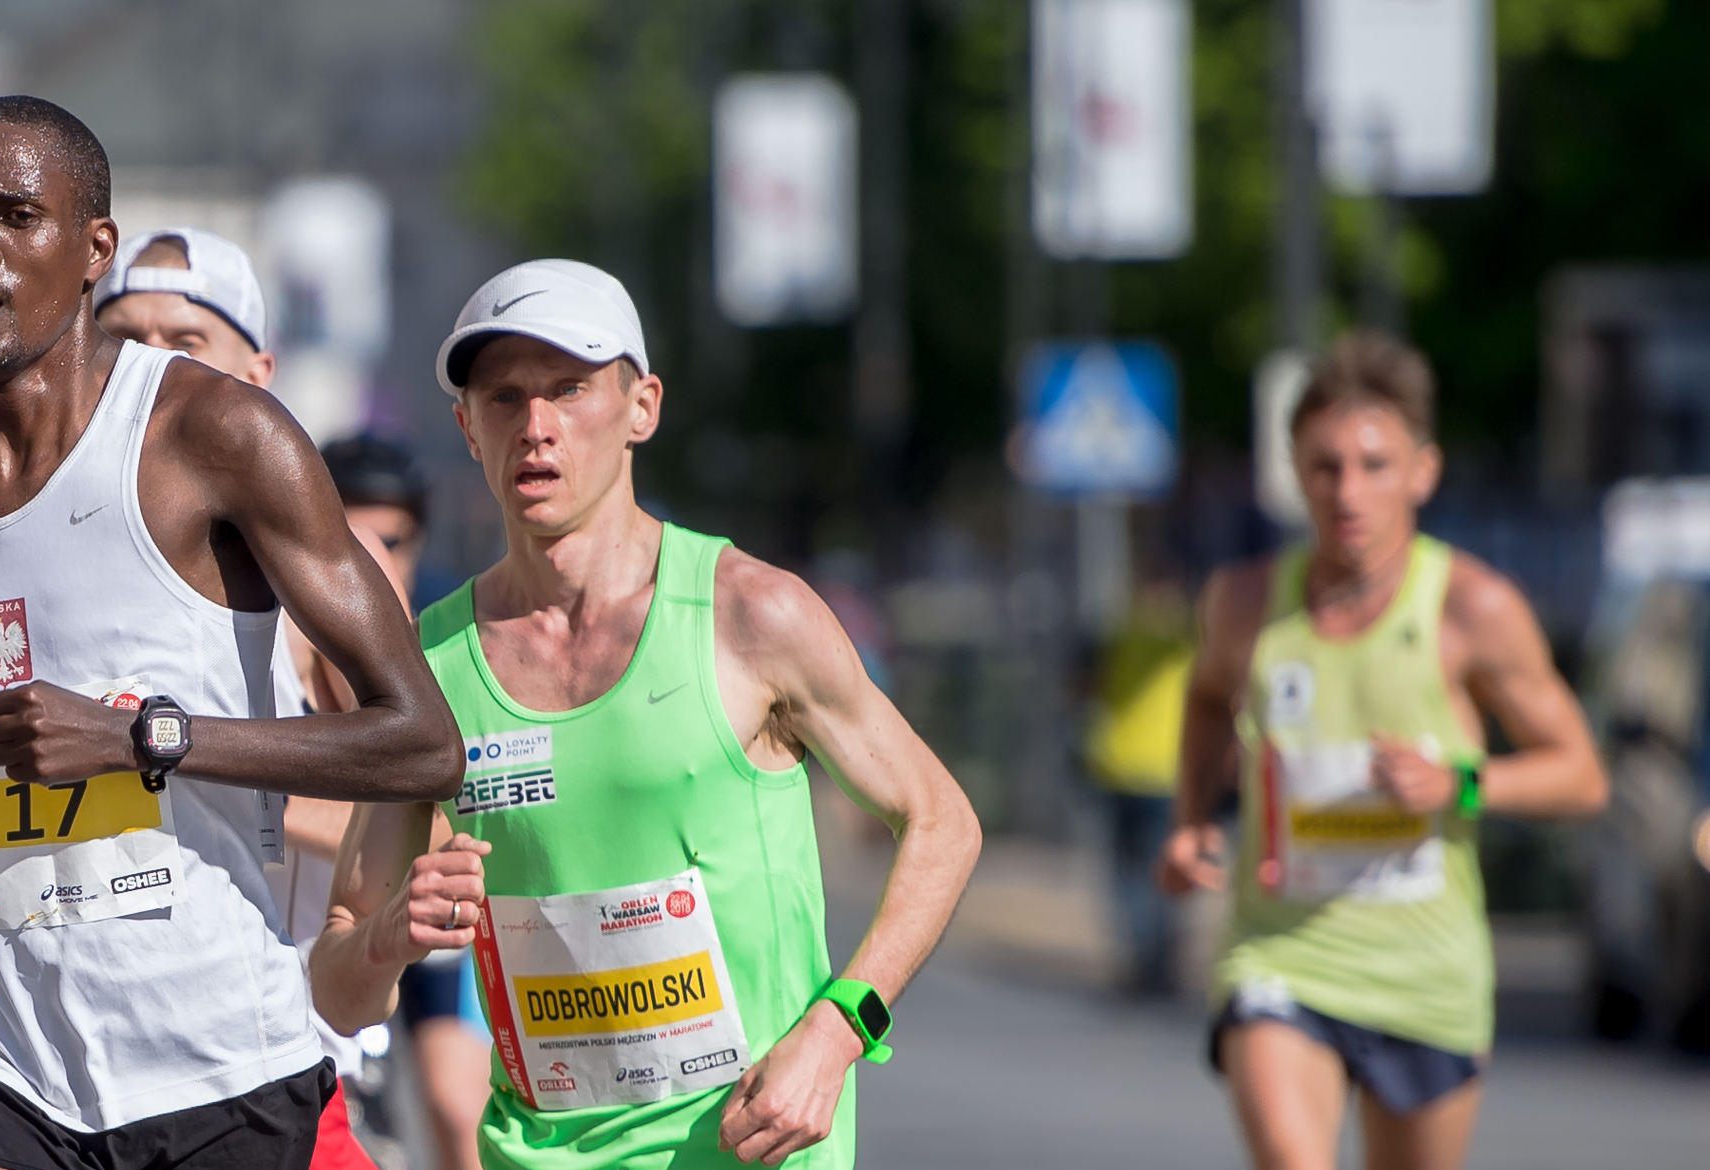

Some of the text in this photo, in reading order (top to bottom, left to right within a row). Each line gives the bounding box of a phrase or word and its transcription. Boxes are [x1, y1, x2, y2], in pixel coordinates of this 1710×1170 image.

[506, 736, 549, 748] LOYALTY
[506, 747, 535, 757] POINT
[5, 780, 88, 841] 17
[114, 869, 170, 892] OSHEE
[55, 885, 83, 896] asics
[621, 895, 658, 910] ORLEN
[611, 904, 660, 920] WARSAW
[601, 913, 663, 931] MARATHON
[526, 968, 706, 1022] DOBROWOLSKI
[538, 1040, 590, 1050] MISTRZOSTWA
[591, 1037, 616, 1047] POLSKI
[658, 1031, 667, 1039] W
[670, 1019, 715, 1036] MARATONIE
[683, 1050, 736, 1073] OSHEE
[628, 1067, 654, 1079] asics
[539, 1079, 573, 1090] ORLEN
